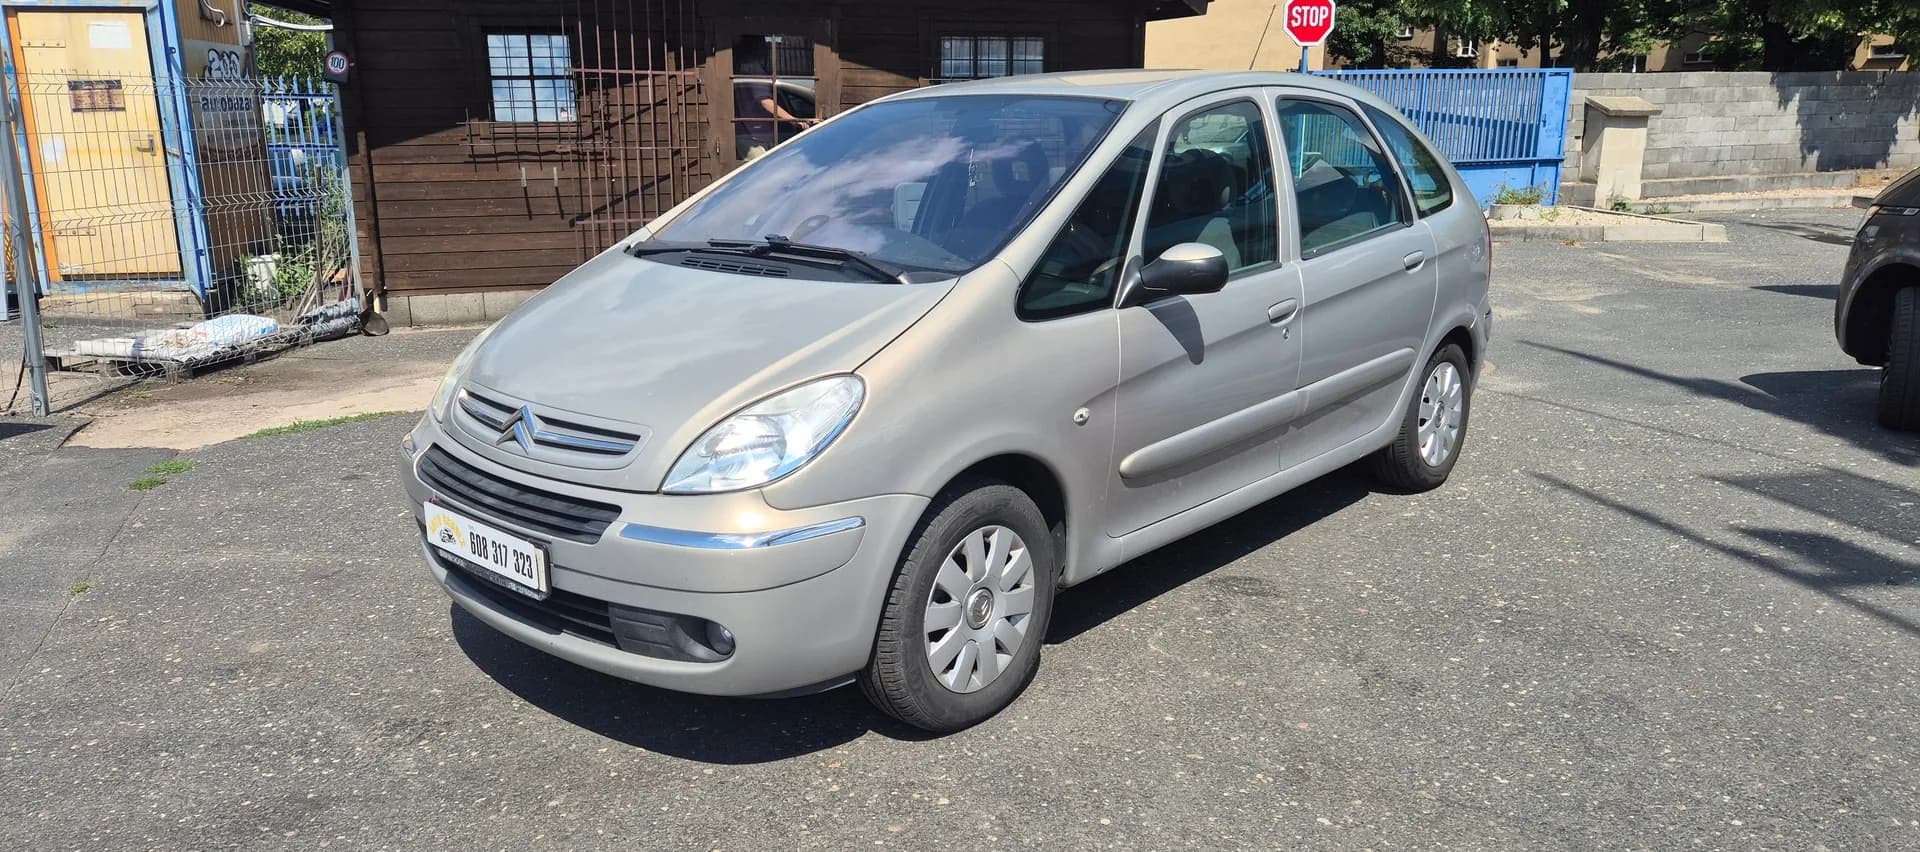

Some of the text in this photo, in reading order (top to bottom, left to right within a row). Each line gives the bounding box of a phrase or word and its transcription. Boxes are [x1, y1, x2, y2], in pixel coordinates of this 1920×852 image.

[1291, 5, 1329, 27] STOP
[331, 56, 345, 69] 100
[201, 95, 253, 112] auobaza
[469, 531, 489, 560] 608
[491, 540, 508, 569] 317
[512, 548, 534, 579] 323
